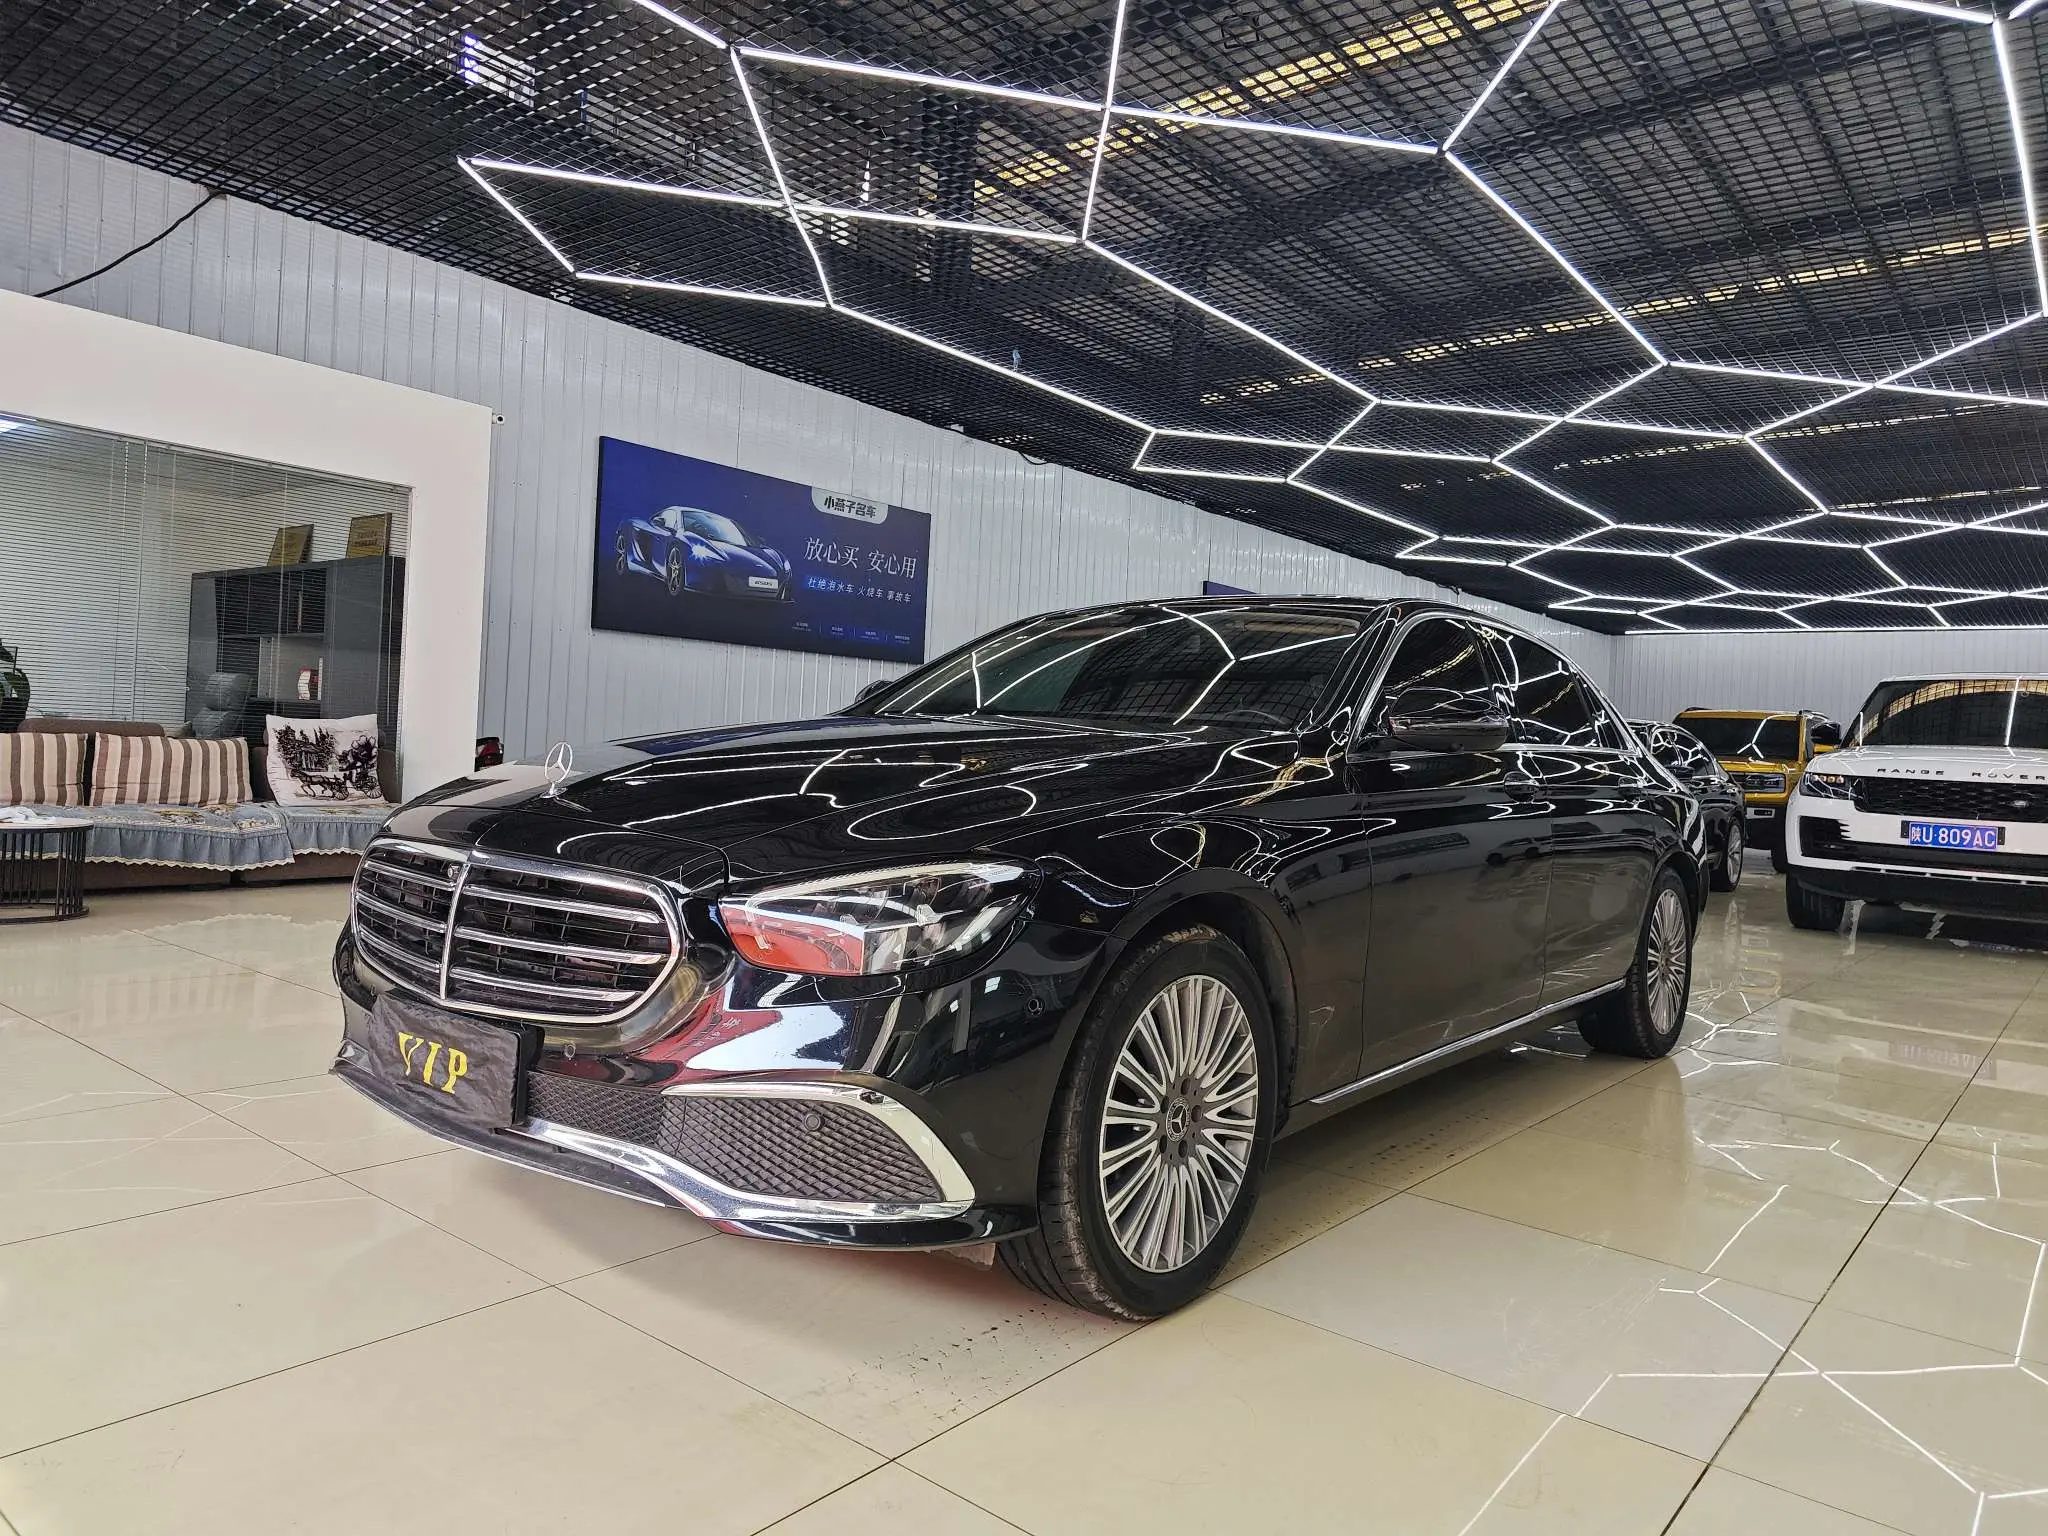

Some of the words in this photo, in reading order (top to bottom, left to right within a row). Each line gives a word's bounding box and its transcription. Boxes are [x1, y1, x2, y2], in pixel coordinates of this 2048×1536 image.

[824, 496, 876, 518] 小燕子名车
[804, 537, 860, 569] 放心买
[867, 550, 917, 579] 安心用
[1877, 768, 1945, 776] RANGE
[1972, 772, 2046, 781] ROVER
[398, 1032, 468, 1095] VIP
